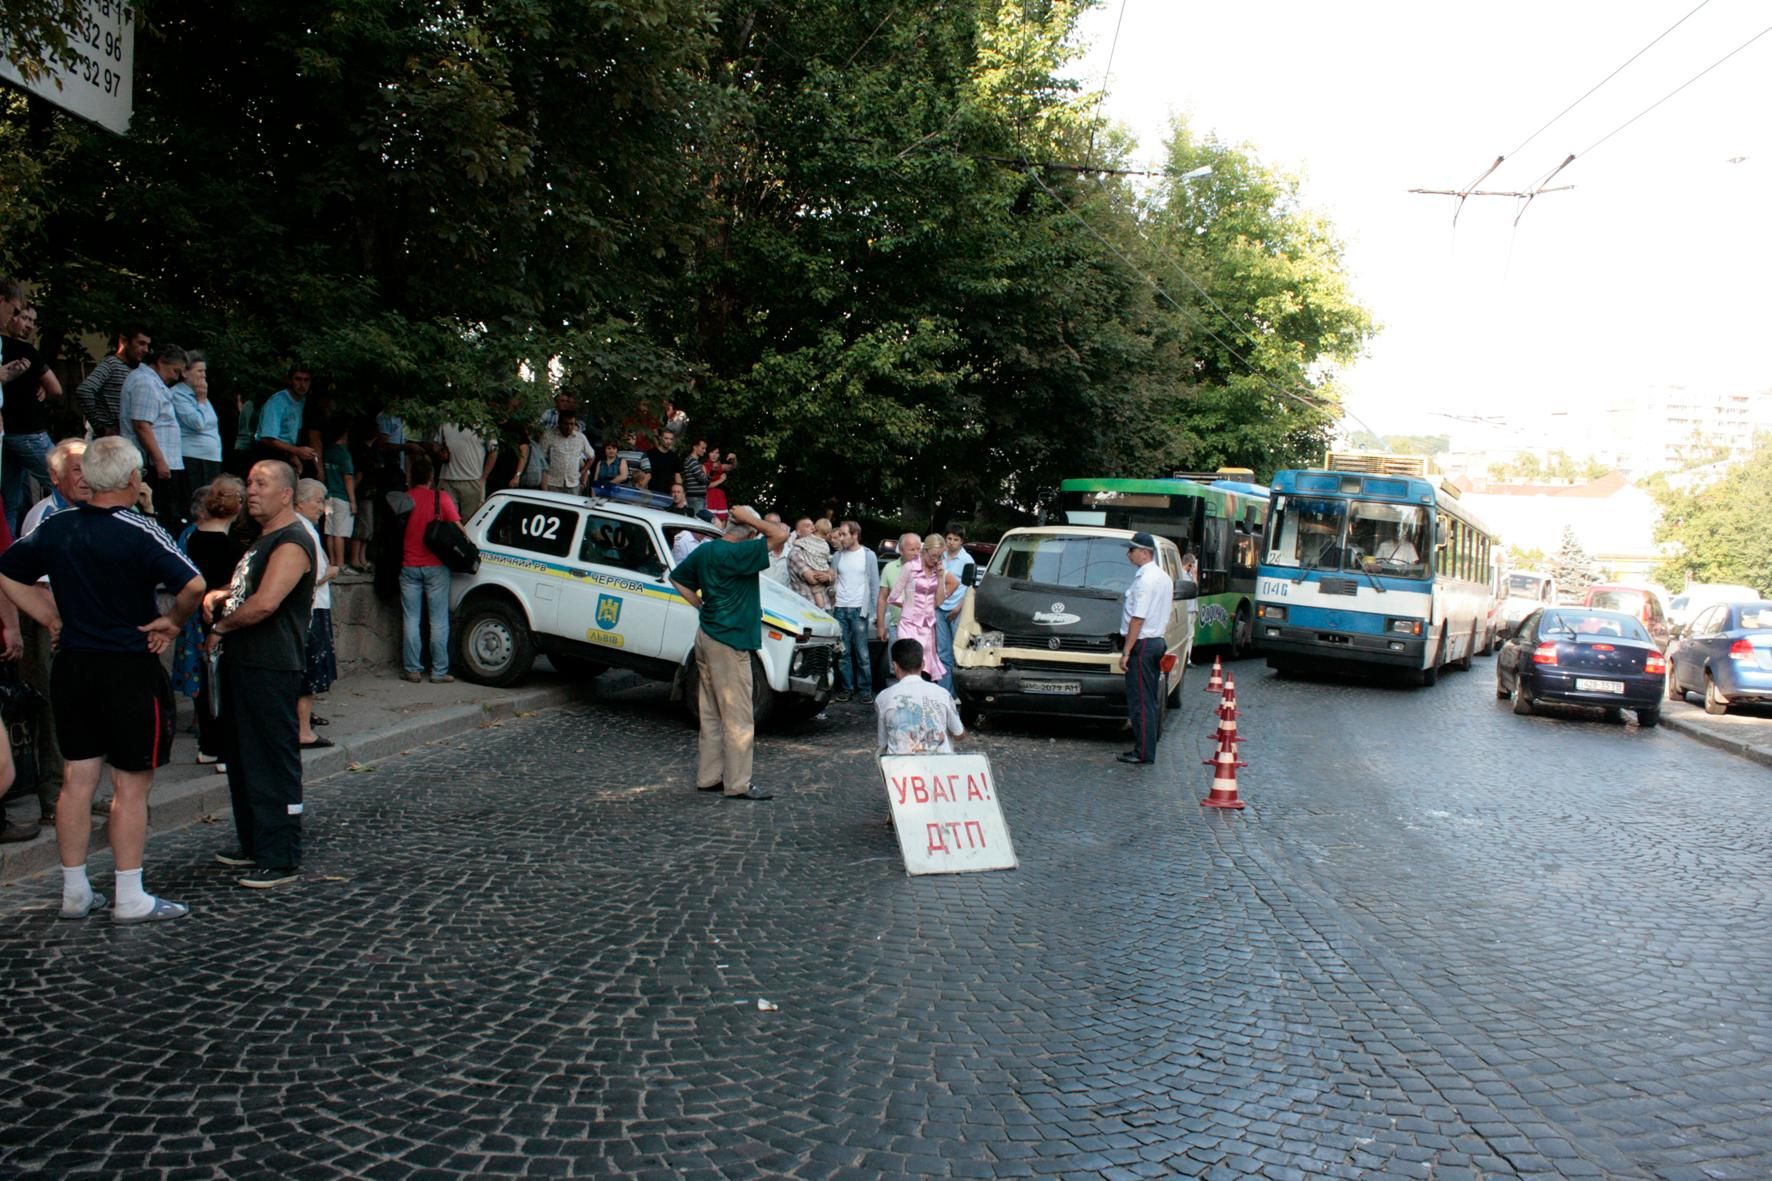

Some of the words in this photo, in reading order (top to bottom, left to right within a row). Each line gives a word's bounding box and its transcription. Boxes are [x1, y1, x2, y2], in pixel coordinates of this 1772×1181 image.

[105, 31, 122, 62] 96
[104, 68, 121, 97] 97
[530, 513, 561, 541] 02
[591, 573, 644, 592] ЧЕРГОВА
[590, 631, 618, 645] ЛЬВІВ
[891, 773, 991, 805] УВАГА!
[927, 820, 986, 856] ДТП
